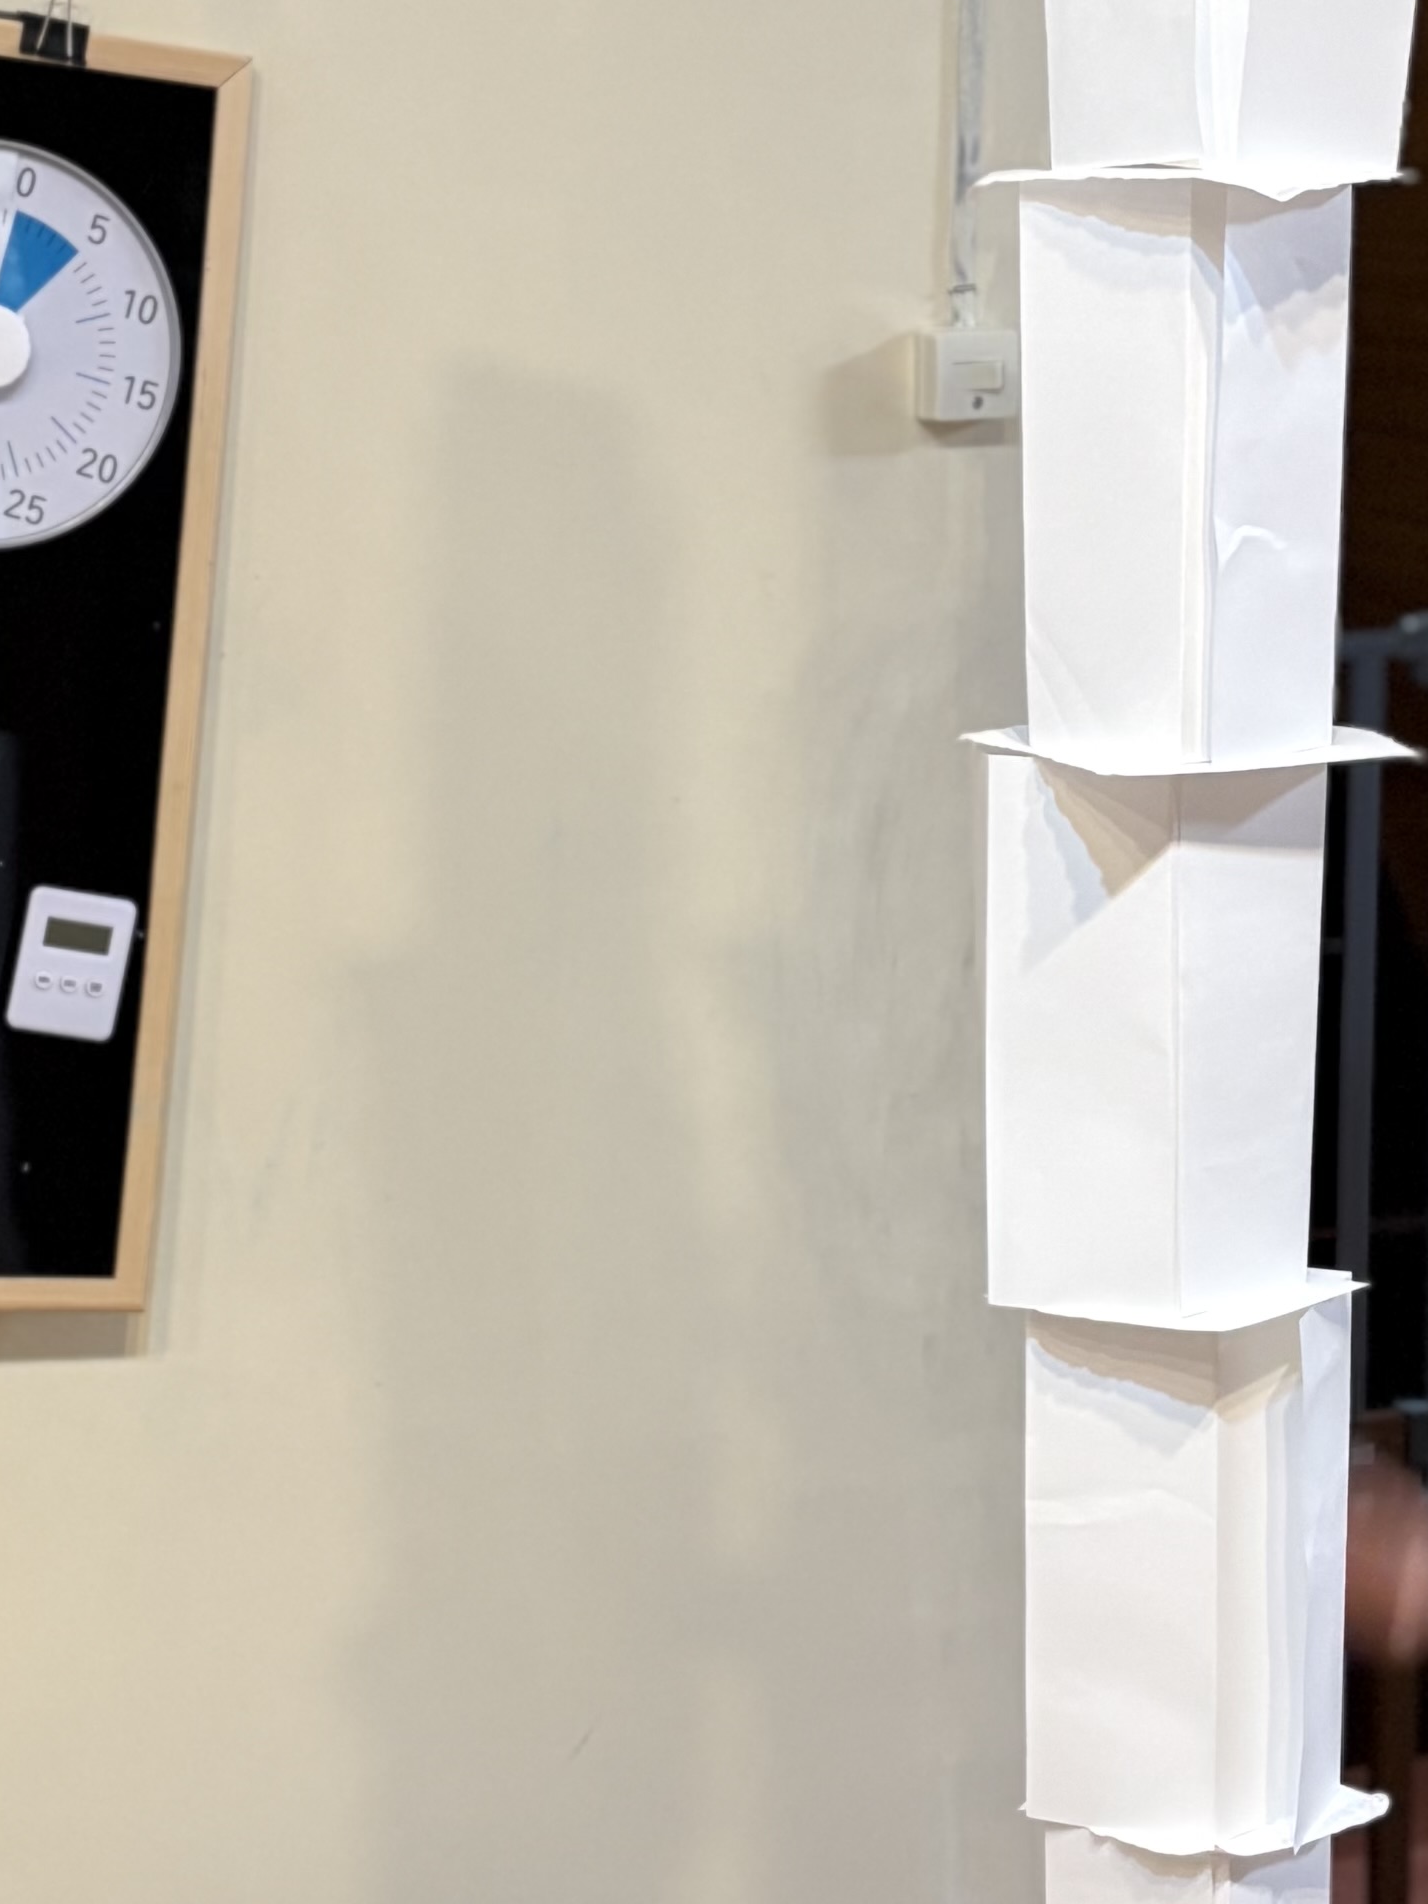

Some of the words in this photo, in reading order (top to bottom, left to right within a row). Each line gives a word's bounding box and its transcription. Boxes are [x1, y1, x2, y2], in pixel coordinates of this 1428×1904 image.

[16, 167, 37, 198] 0
[87, 214, 111, 245] 5
[124, 289, 159, 325] 10
[124, 375, 160, 411] 15
[76, 447, 118, 484] 20
[3, 489, 48, 526] 25
